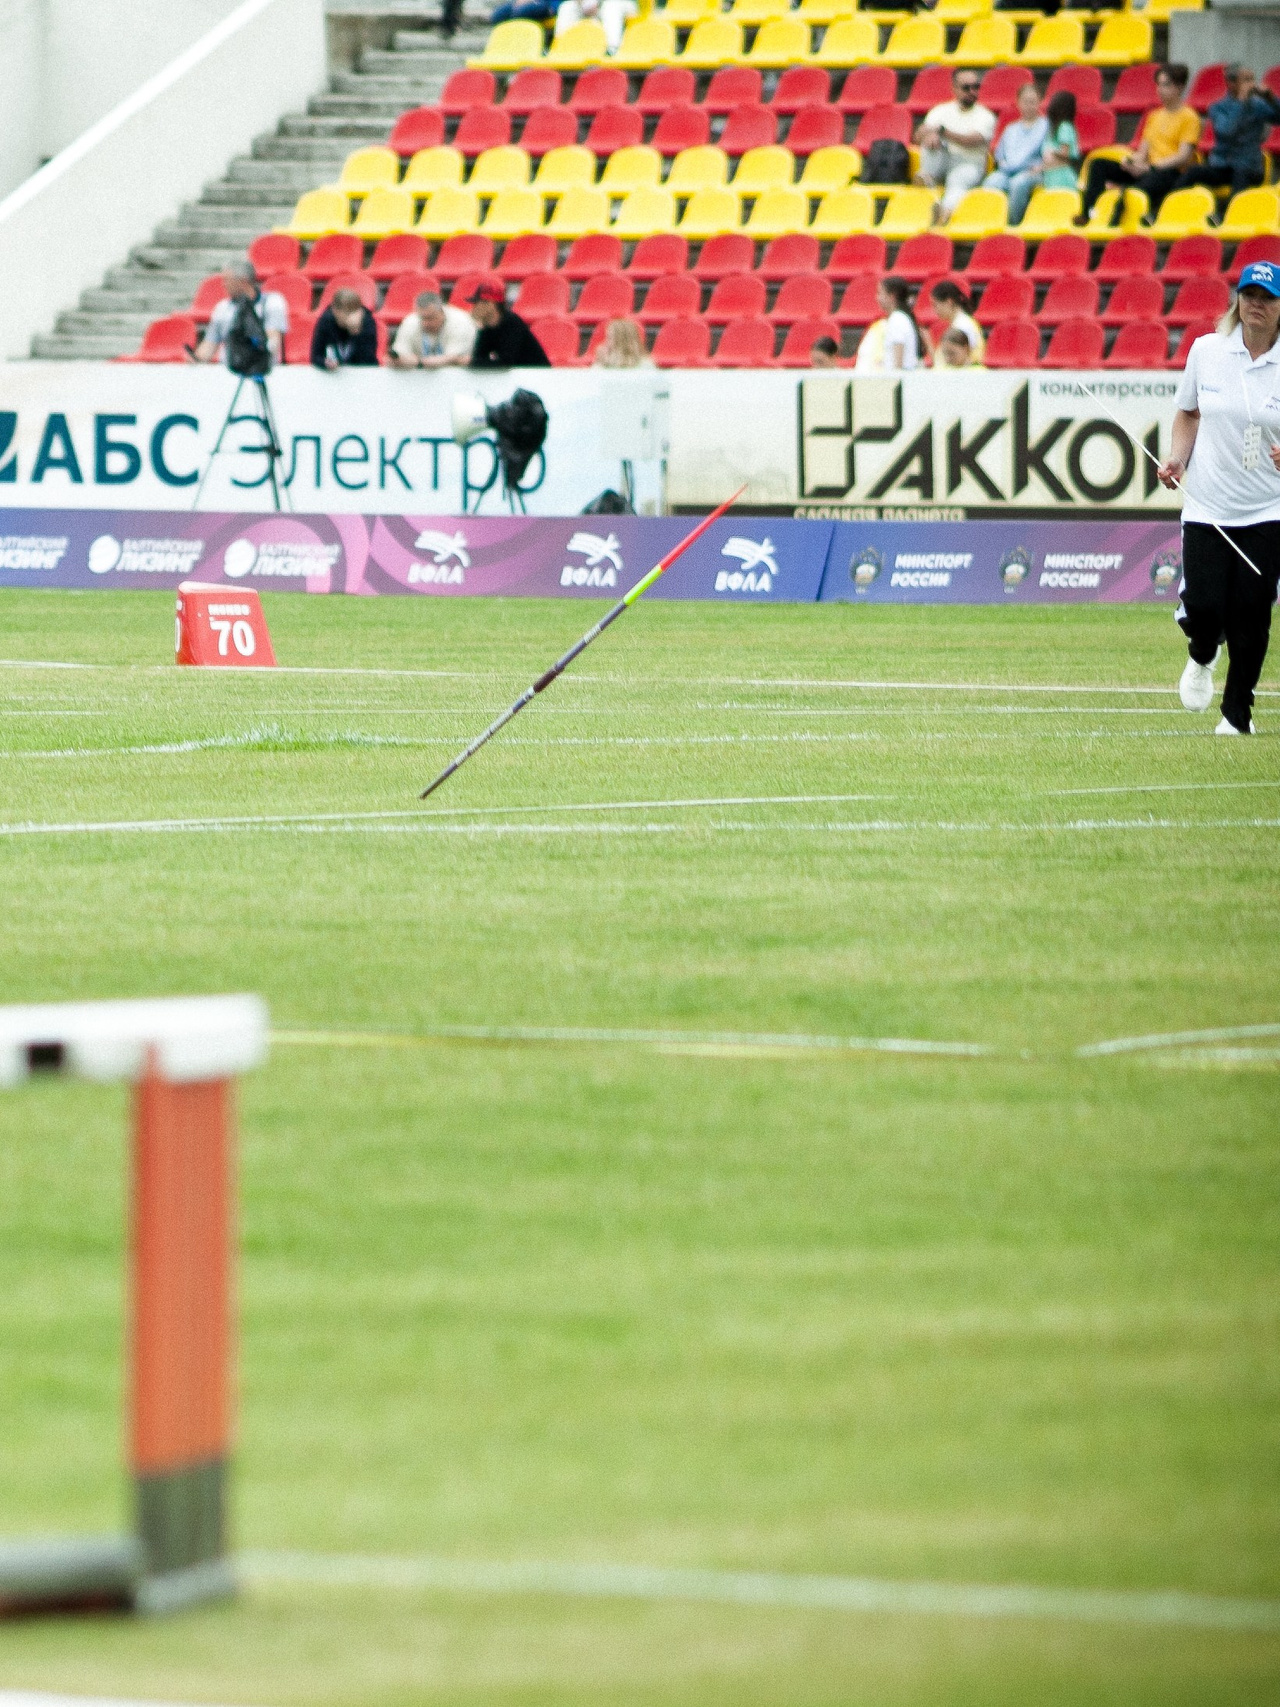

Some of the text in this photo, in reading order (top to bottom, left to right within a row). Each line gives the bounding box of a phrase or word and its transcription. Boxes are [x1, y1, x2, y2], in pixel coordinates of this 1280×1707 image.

[30, 413, 546, 512] АБС Электро
[894, 553, 973, 570] МИНСПОРТ
[1044, 554, 1123, 571] МИНСПОРТ
[407, 563, 465, 584] ВФЛА
[560, 566, 616, 587] ВФЛА
[715, 571, 771, 592] ВФЛА
[890, 572, 952, 587] РОССИИ
[1039, 572, 1100, 588] РОССИИ
[209, 616, 256, 656] 70
